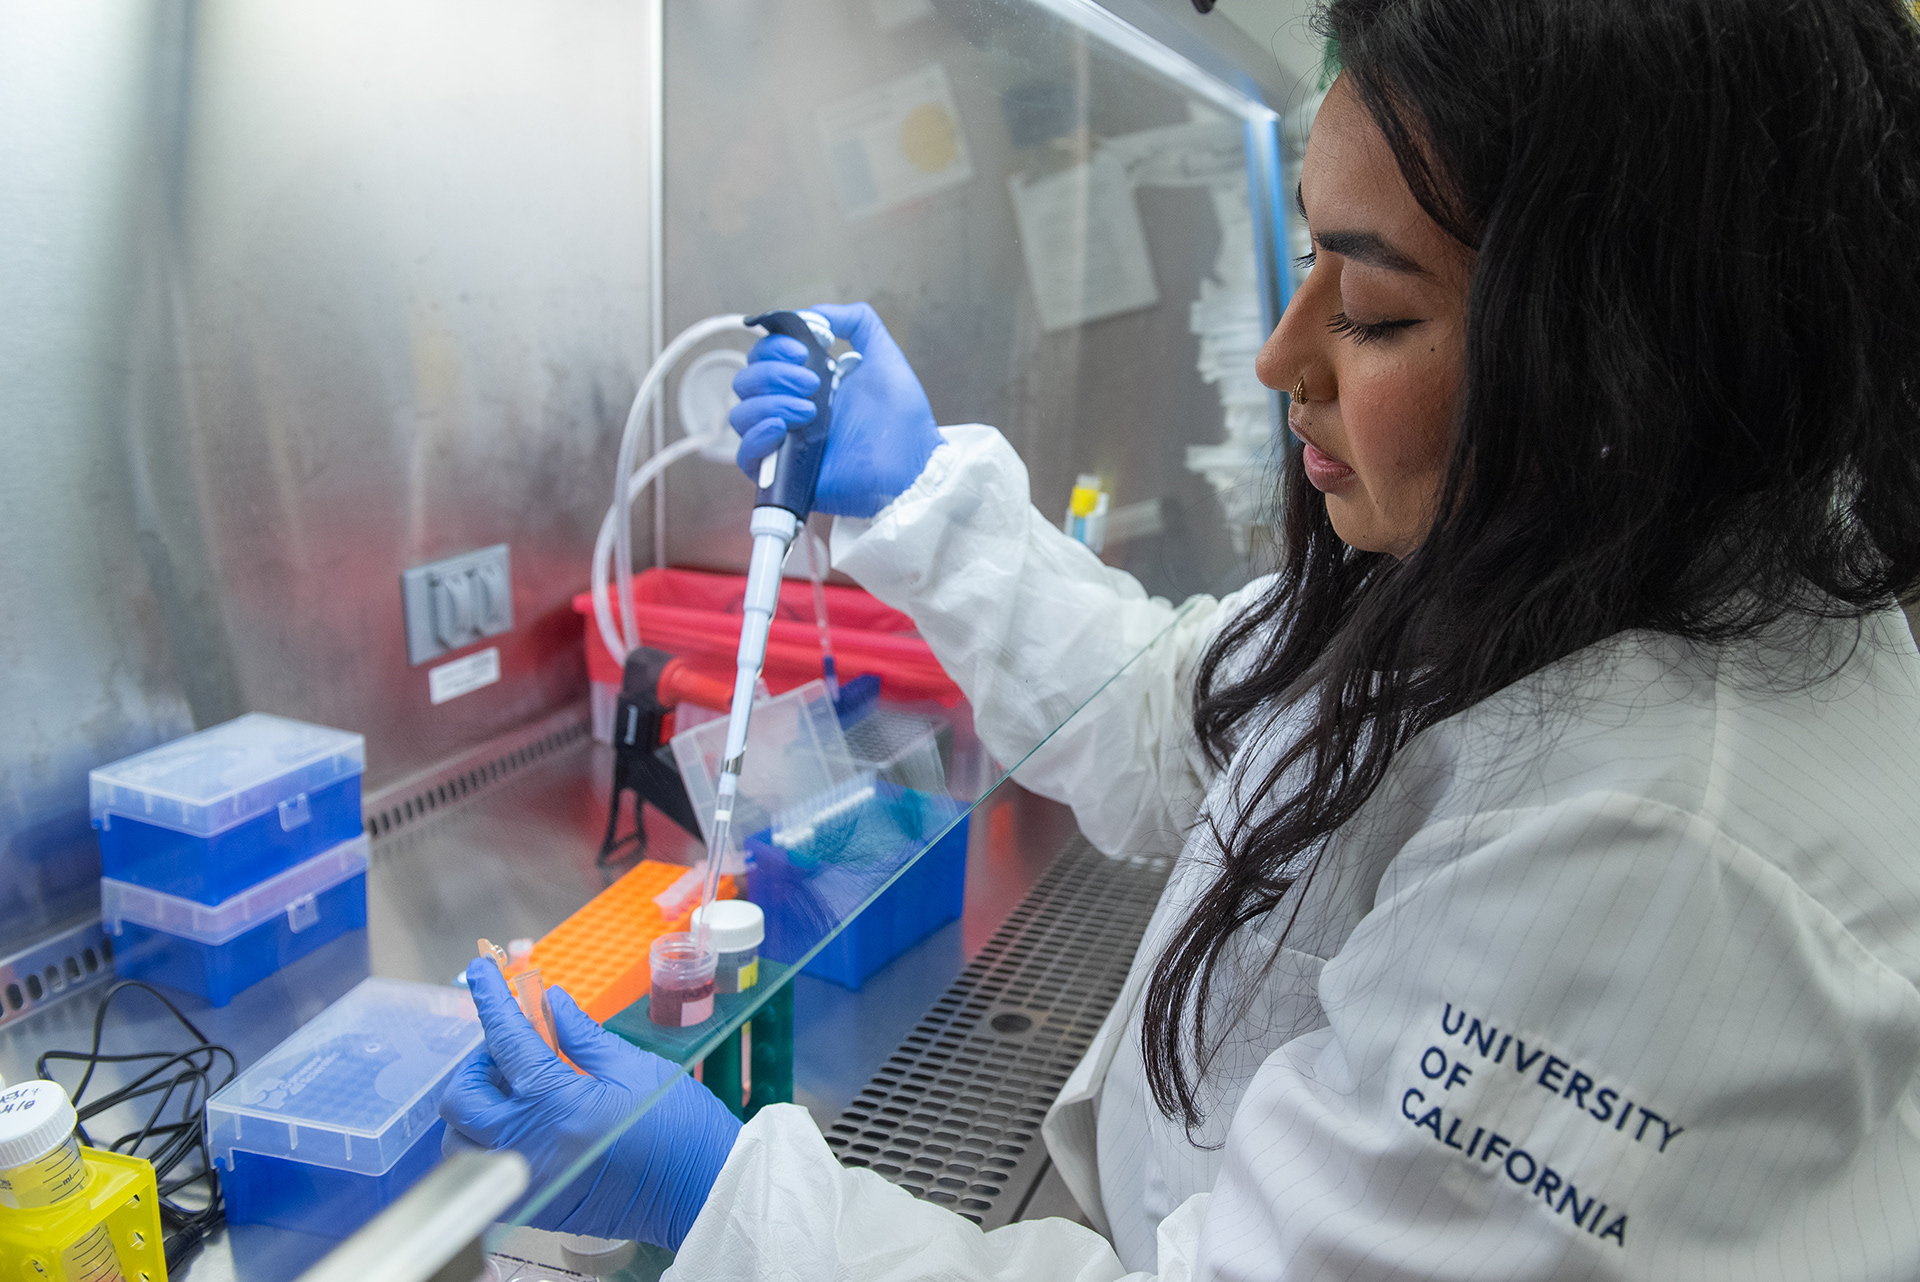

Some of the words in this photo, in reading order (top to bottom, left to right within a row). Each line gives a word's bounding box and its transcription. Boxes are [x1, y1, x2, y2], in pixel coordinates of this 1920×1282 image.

[1420, 1046, 1473, 1091] OF
[1442, 1002, 1685, 1154] UNIVERSITY
[1402, 1088, 1629, 1249] CALIFORNIA
